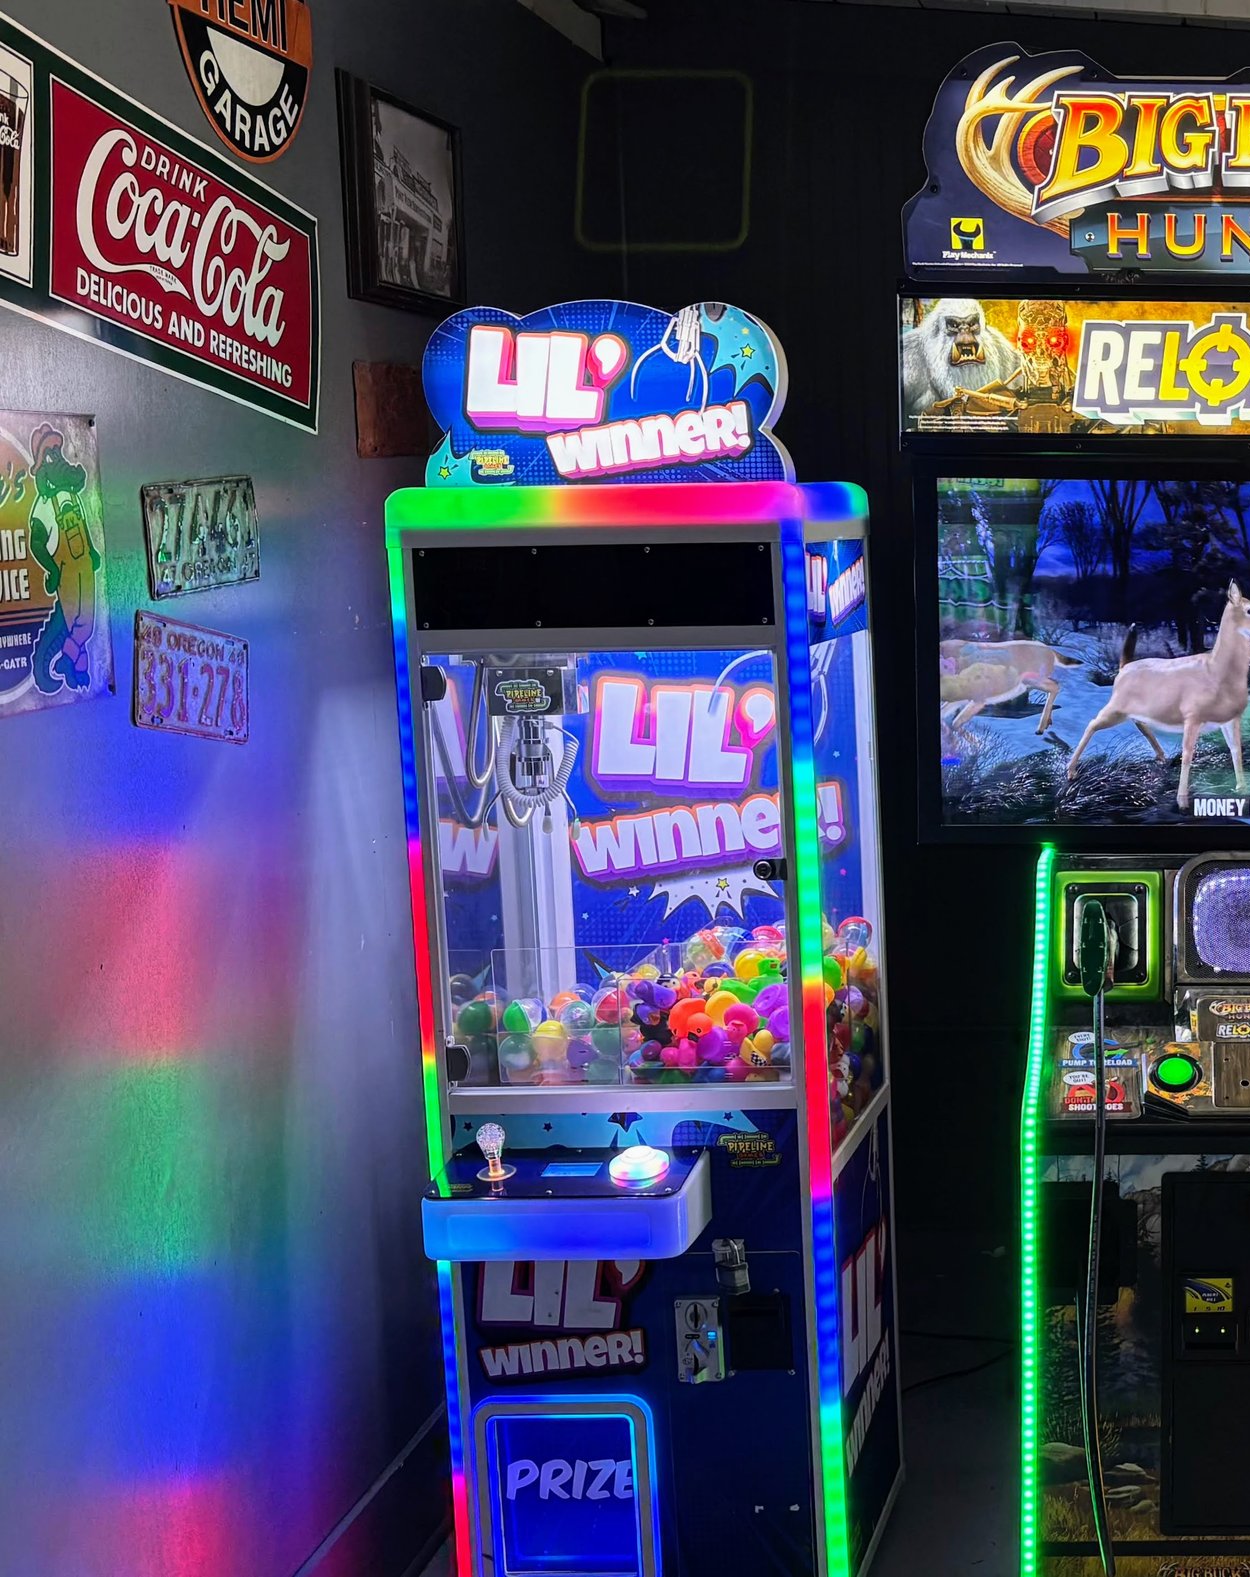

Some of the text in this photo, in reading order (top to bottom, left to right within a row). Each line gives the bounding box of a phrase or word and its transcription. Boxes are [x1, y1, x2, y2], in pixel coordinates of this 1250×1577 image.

[200, 50, 298, 151] GARAGE
[1035, 92, 1217, 205] BIG
[140, 146, 211, 202] DRINK
[76, 129, 290, 347] Coca-Cola
[76, 267, 292, 388] DELICIOUS AND REFRESHING
[465, 325, 628, 422] LIL'
[167, 631, 225, 661] OREGON
[505, 689, 542, 699] PIPELINE
[1194, 799, 1245, 816] MONEY
[1221, 1003, 1243, 1013] BIG
[728, 1141, 774, 1151] PIPELINE
[506, 1459, 636, 1500] PRIZE
[1204, 1567, 1241, 1577] BUCK
